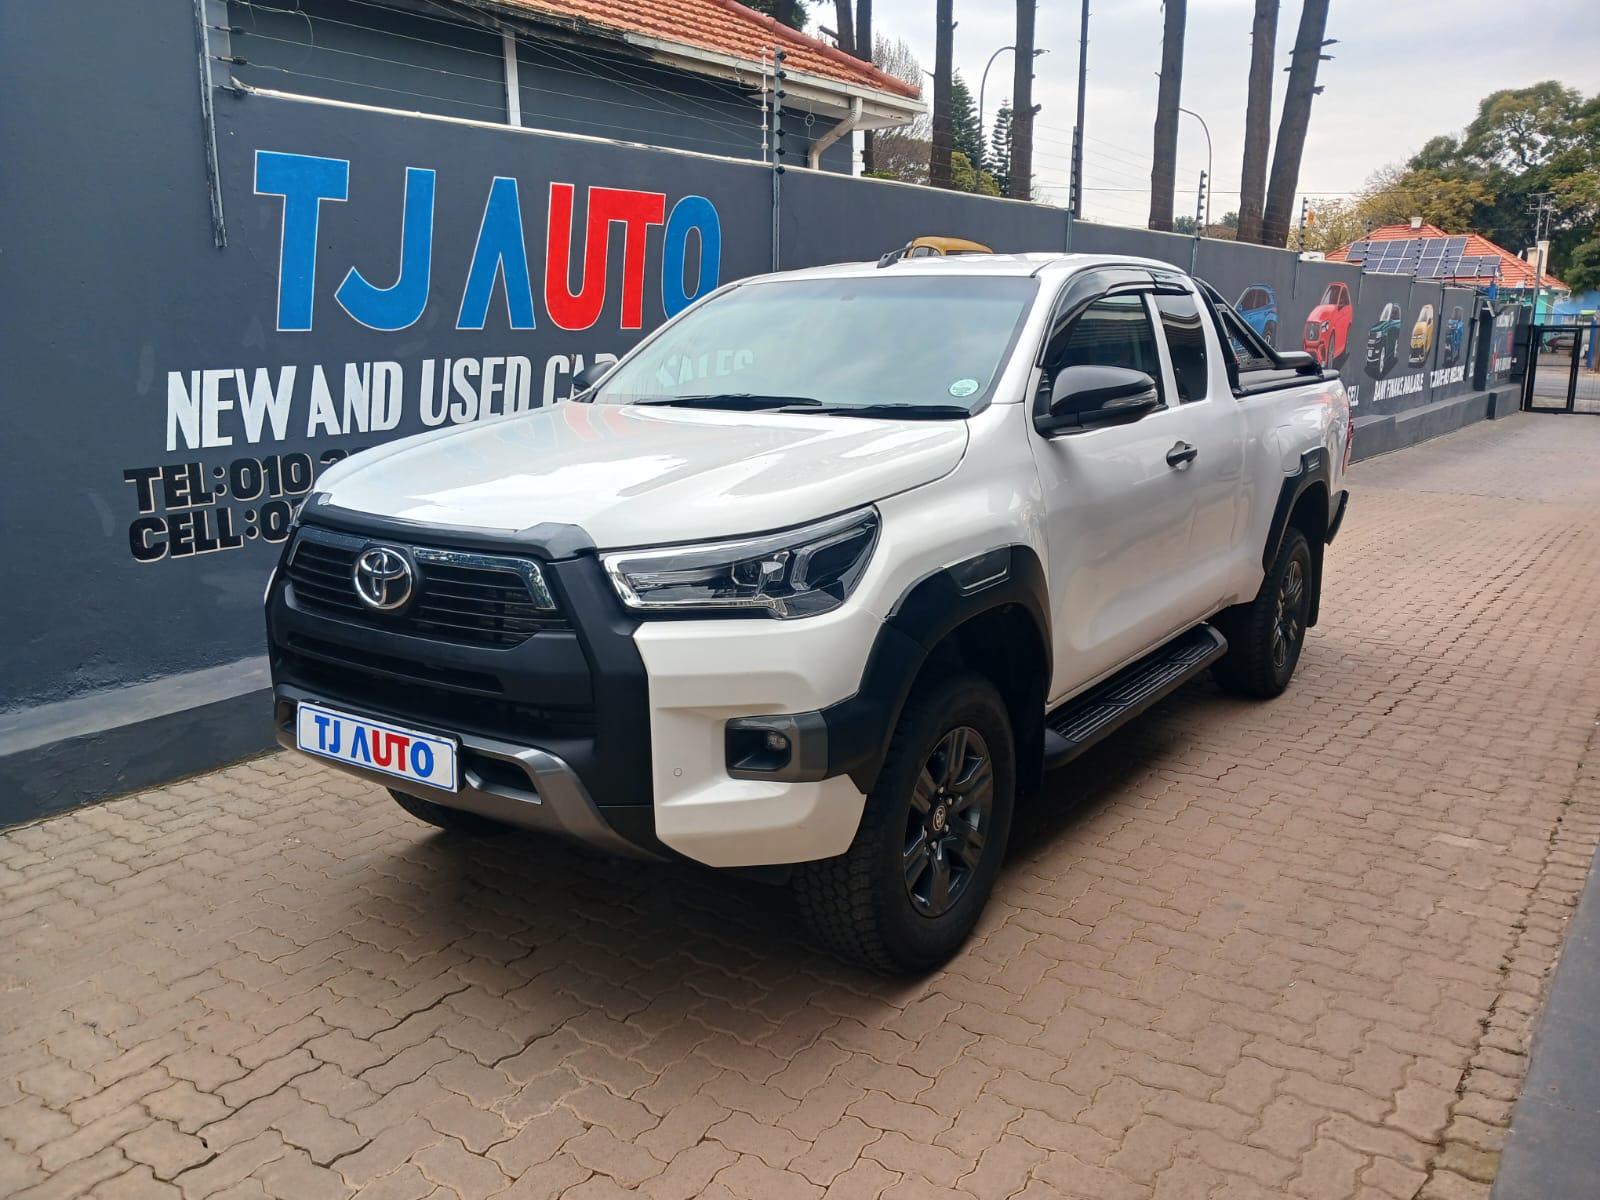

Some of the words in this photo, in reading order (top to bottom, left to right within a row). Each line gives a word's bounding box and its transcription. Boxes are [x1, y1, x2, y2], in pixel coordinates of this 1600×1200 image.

[254, 150, 436, 331] TJ
[456, 176, 721, 330] AUTO
[166, 365, 297, 452] NEW
[306, 361, 403, 438] AND
[420, 355, 532, 427] USED
[129, 499, 302, 563] CELL:0
[315, 715, 341, 753] TJ
[351, 726, 434, 778] AUTO
